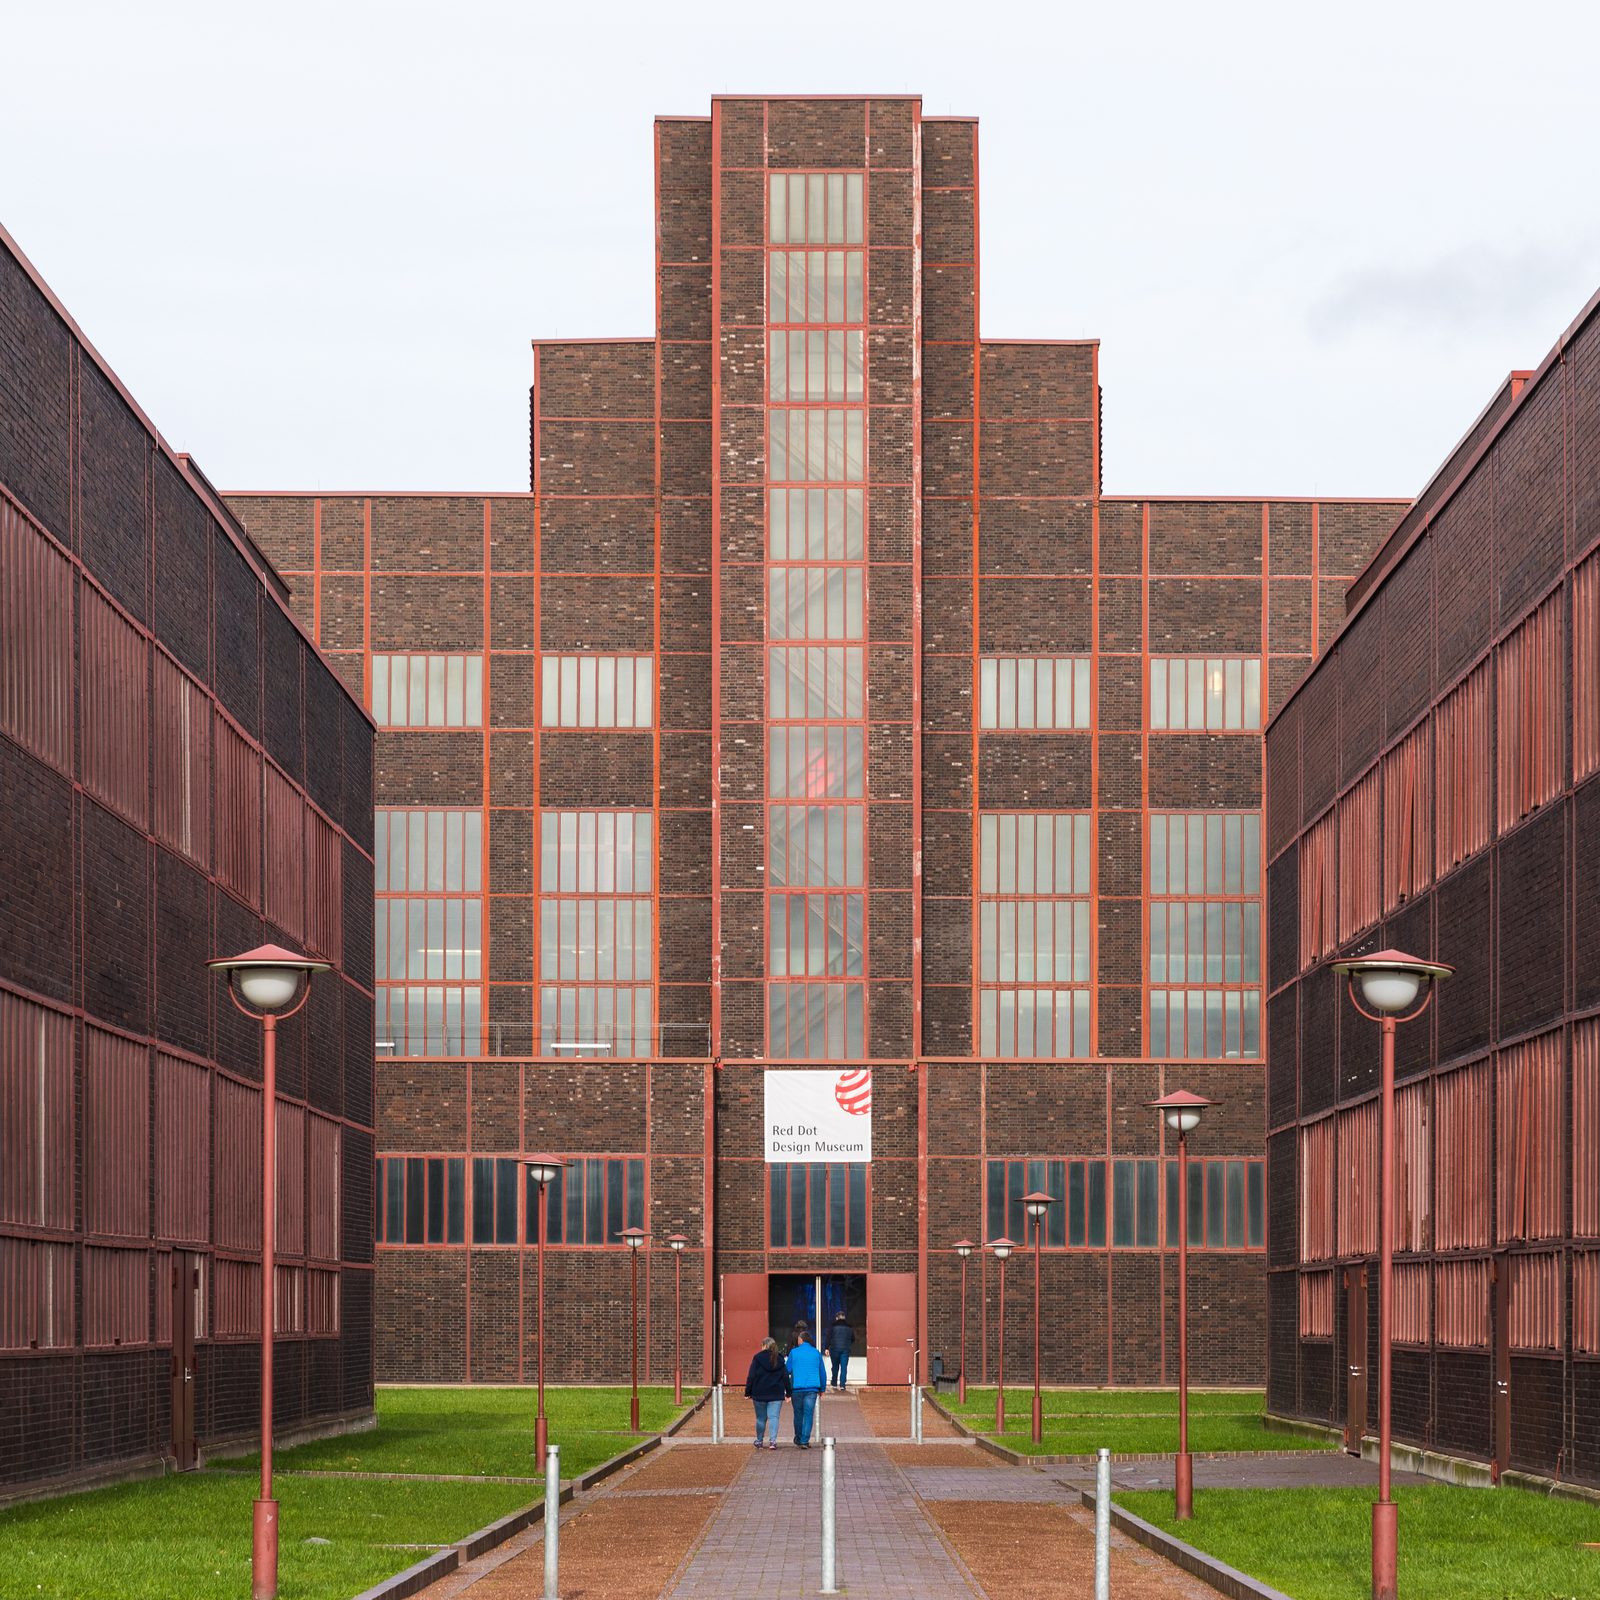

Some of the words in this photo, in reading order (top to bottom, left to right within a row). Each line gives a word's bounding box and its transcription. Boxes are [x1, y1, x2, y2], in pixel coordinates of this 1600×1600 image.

[772, 1125, 793, 1136] Red
[798, 1125, 817, 1136] Dot
[772, 1141, 811, 1154] Design
[815, 1141, 864, 1152] Museum
